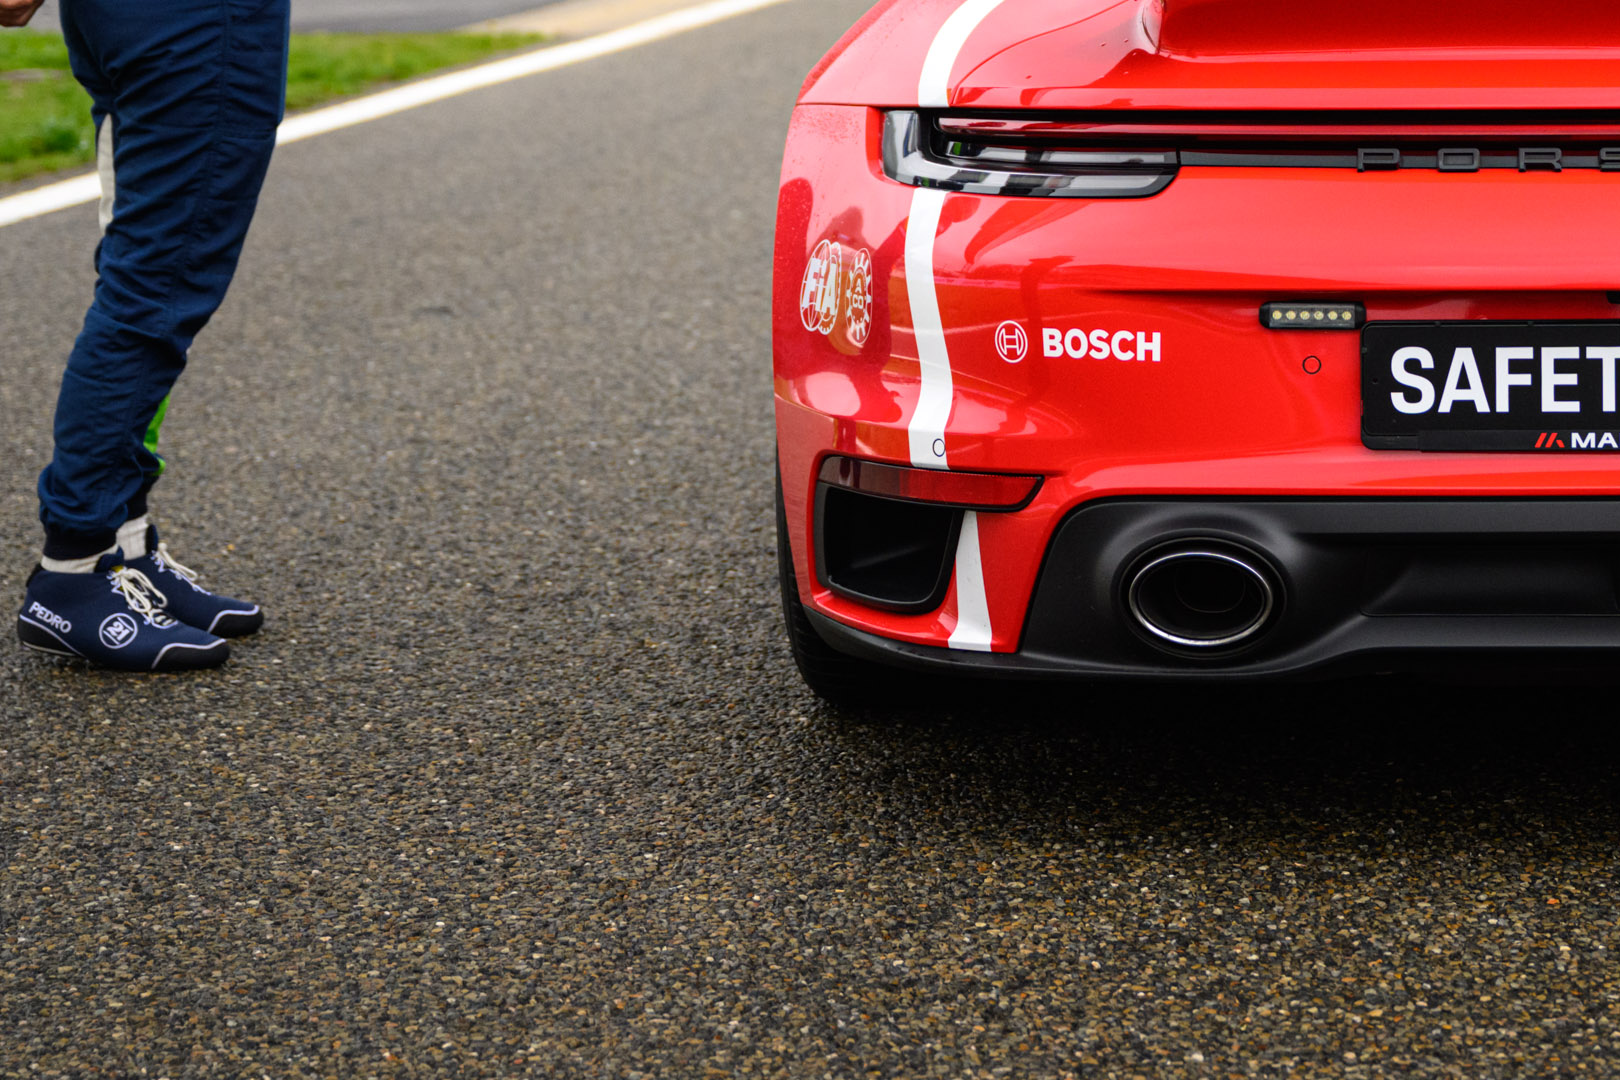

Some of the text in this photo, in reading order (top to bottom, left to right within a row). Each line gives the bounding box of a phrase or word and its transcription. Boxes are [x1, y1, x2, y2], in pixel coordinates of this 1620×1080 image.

[802, 256, 837, 317] FIA
[1041, 327, 1162, 362] BOSCH
[28, 601, 72, 633] PEDRO
[106, 621, 130, 641] 21
